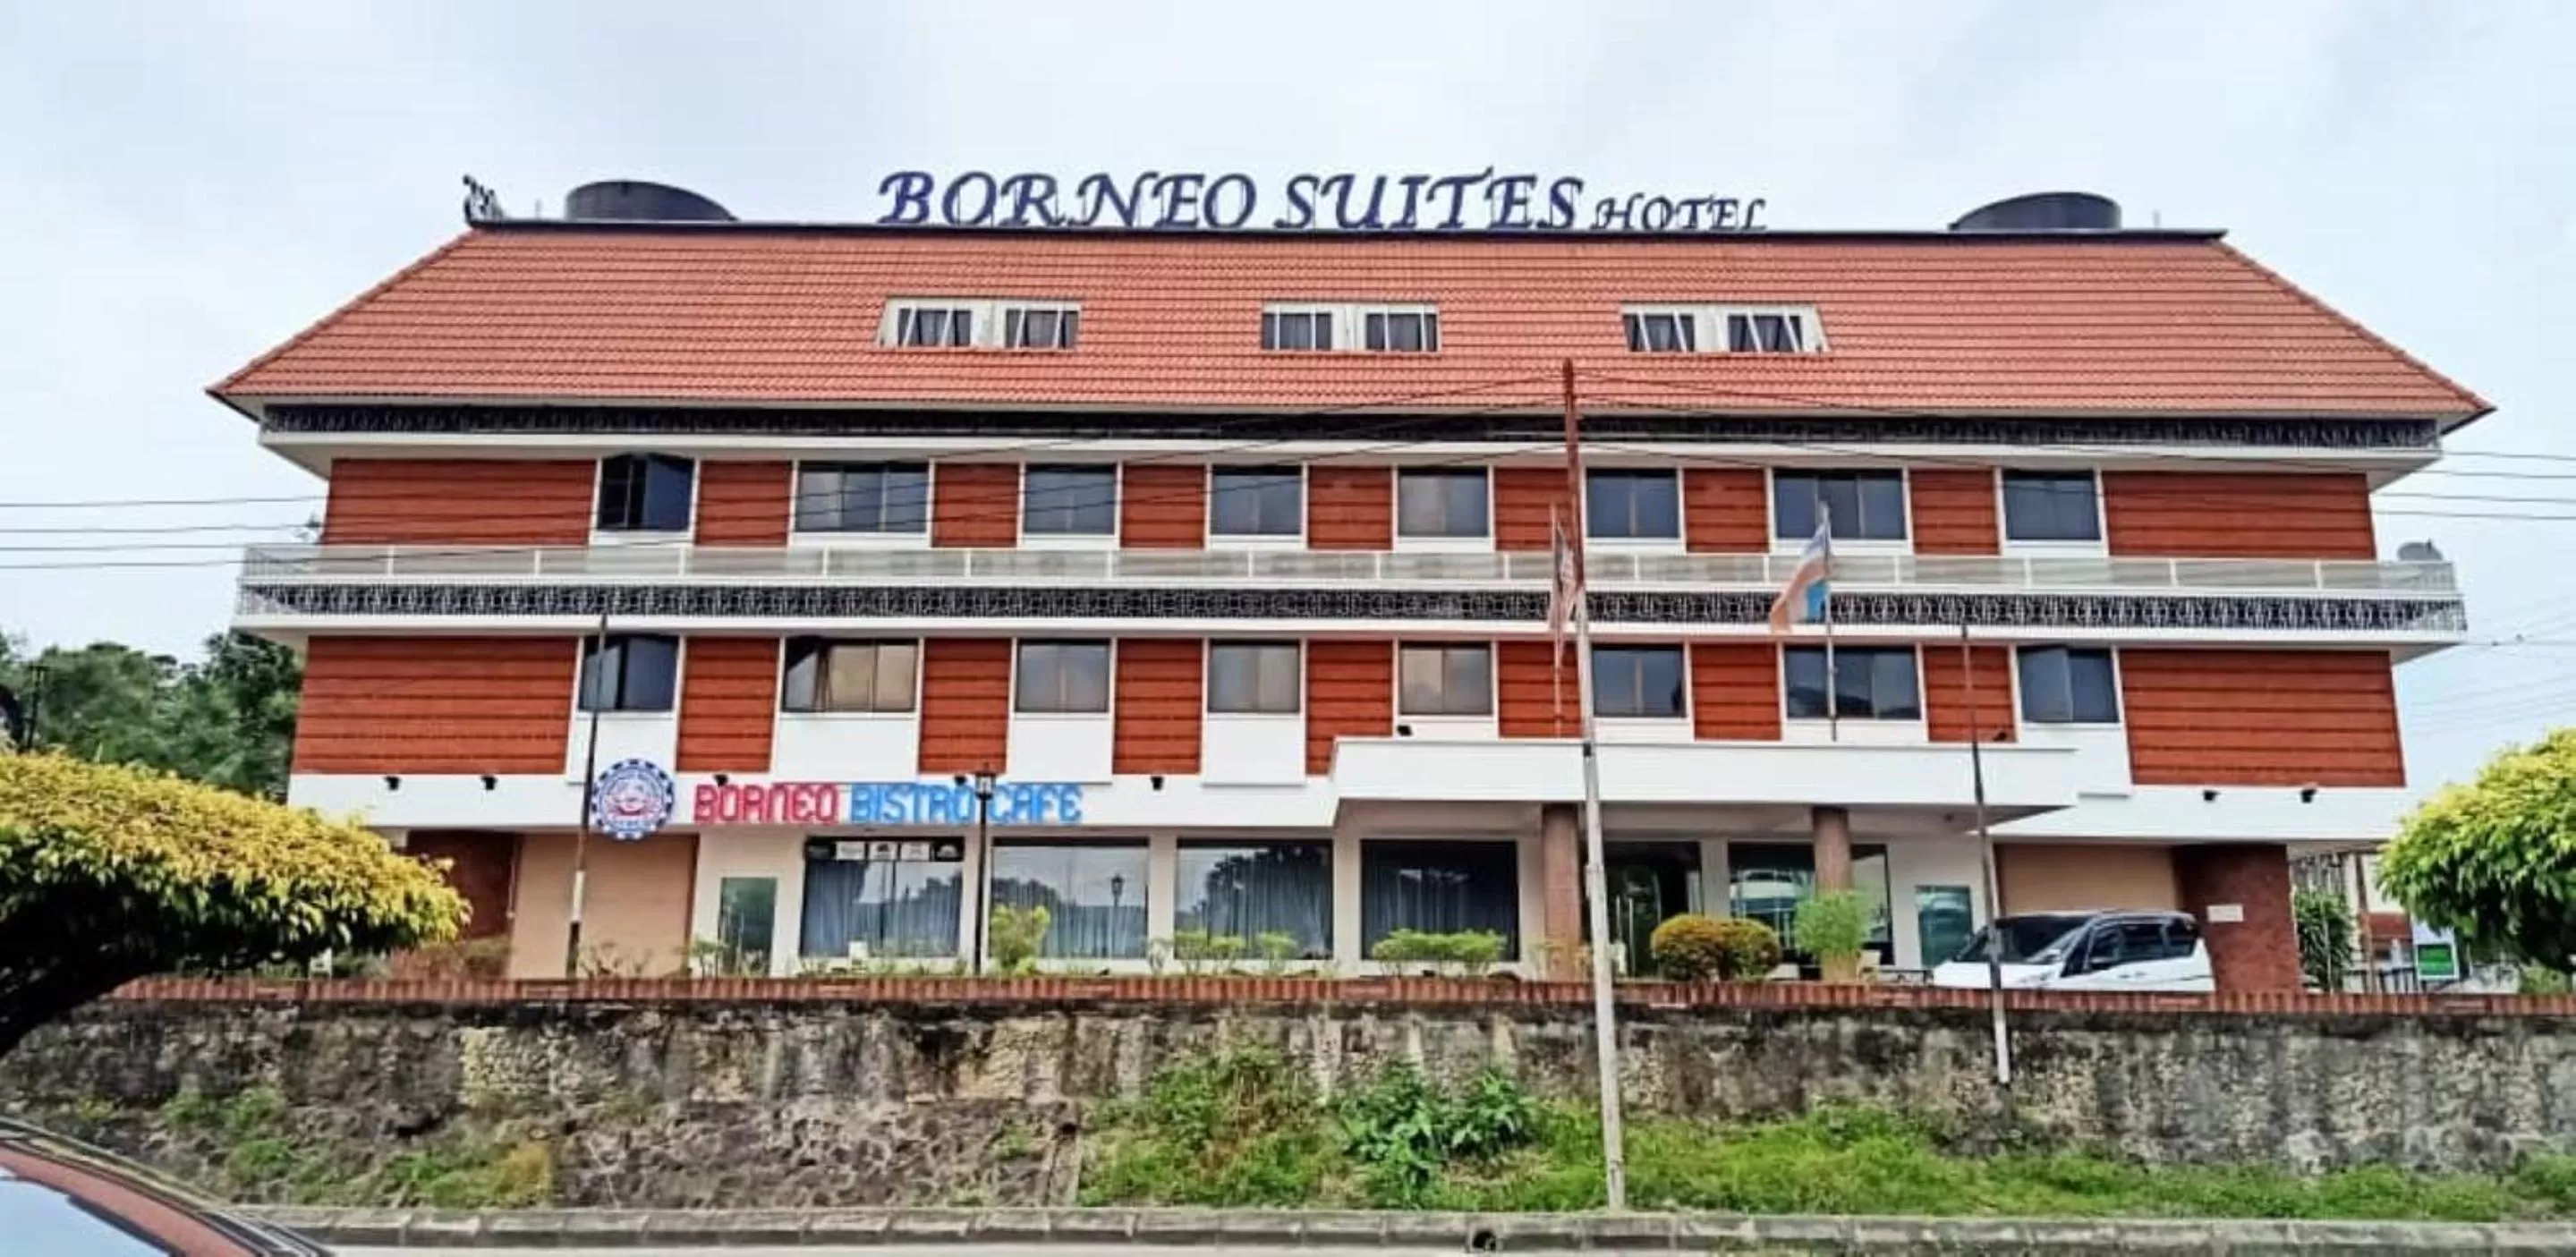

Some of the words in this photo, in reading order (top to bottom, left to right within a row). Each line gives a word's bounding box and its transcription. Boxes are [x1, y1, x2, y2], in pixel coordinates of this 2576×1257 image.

[879, 171, 1256, 228] BORNEO
[1275, 167, 1584, 229] SUITES
[1593, 193, 1766, 230] HOTEL
[693, 784, 839, 824] BORNEO
[850, 783, 975, 824] BISTRO
[988, 784, 1083, 824] CAFE
